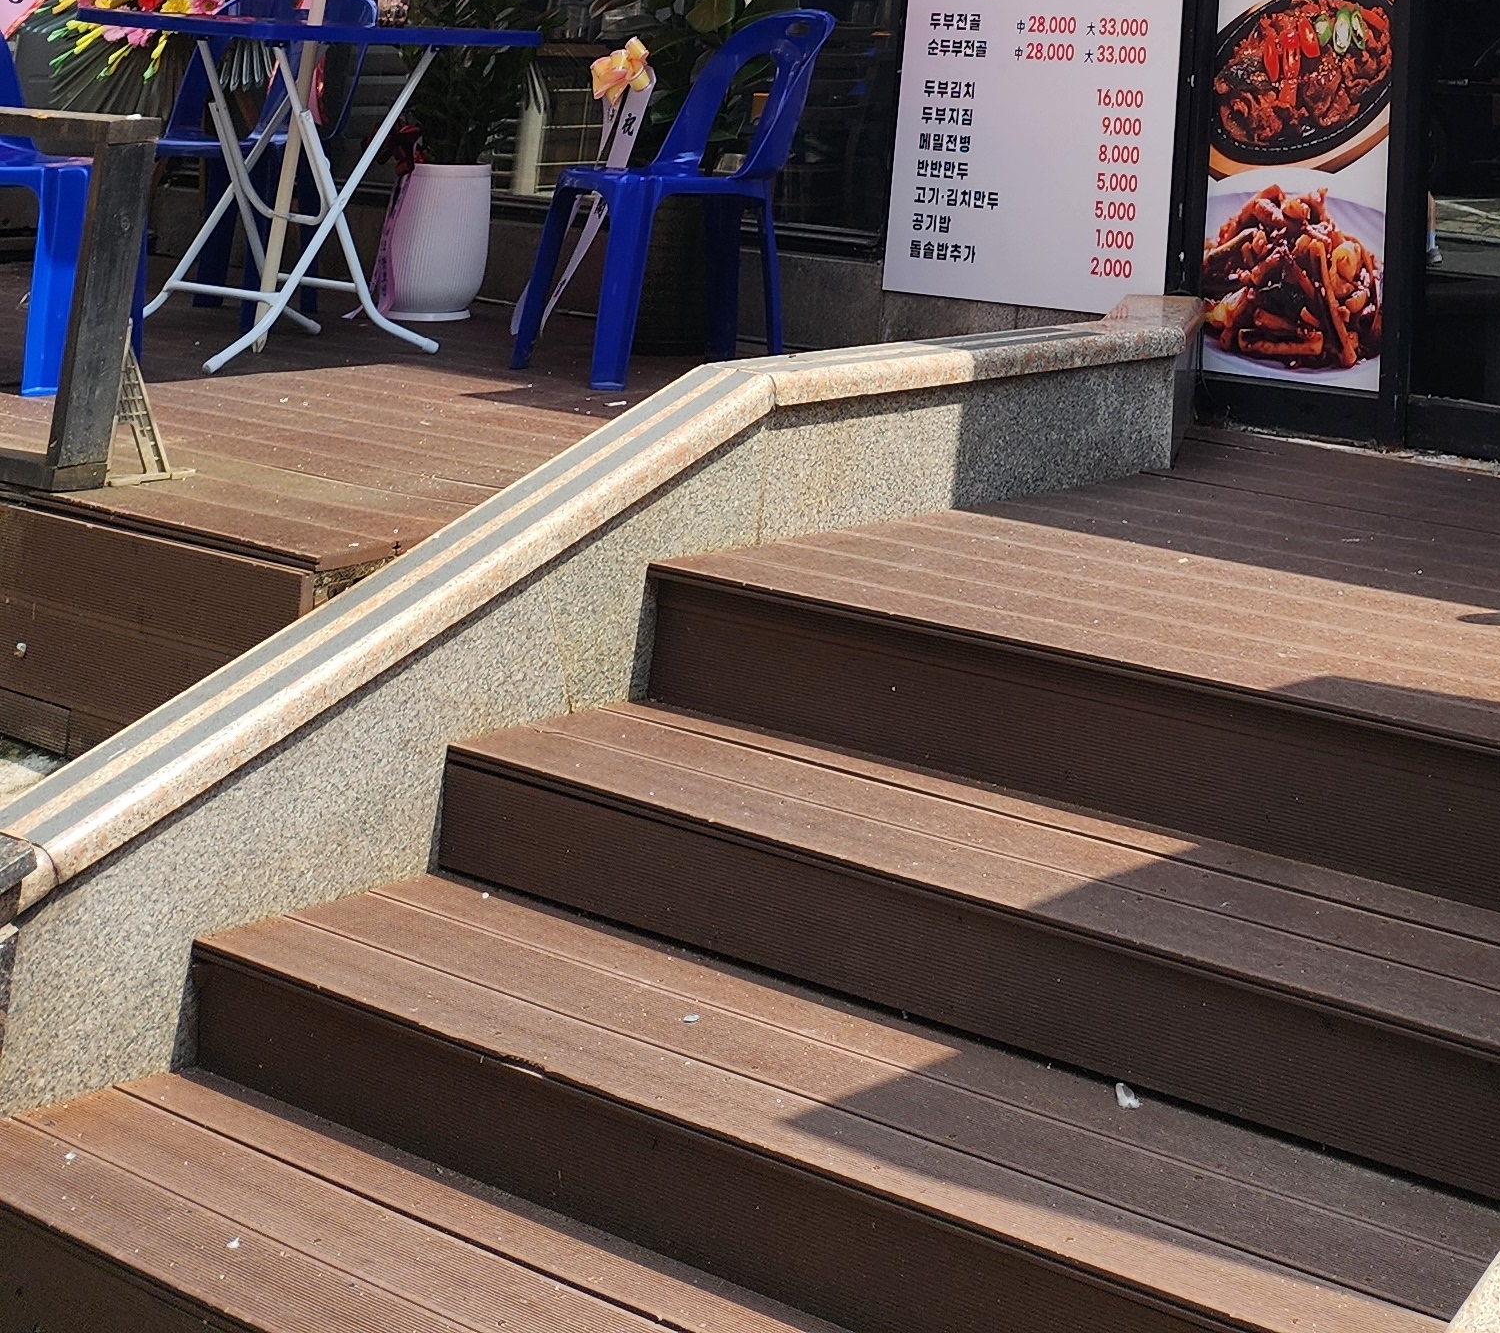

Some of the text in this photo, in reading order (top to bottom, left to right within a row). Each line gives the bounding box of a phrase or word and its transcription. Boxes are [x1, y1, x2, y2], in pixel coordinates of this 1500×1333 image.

[929, 12, 981, 31] 두부전골
[1028, 15, 1077, 35] 28,000
[1098, 18, 1149, 37] 33,000
[927, 38, 988, 58] 순두부전골
[1025, 42, 1075, 61] 28,000
[1096, 46, 1147, 65] 33,000
[923, 80, 1144, 109] 두부김치 16,000
[921, 106, 1142, 136] 두부지짐 9,000
[919, 133, 1140, 164] 메밀전병 8,000
[916, 159, 1138, 193] 반반만두 5,000
[913, 186, 1136, 221] 고기·김치만두 5,000
[912, 212, 1134, 250] 공기밥 1,000
[909, 239, 1133, 279] 돌솥밥추가 2,000
